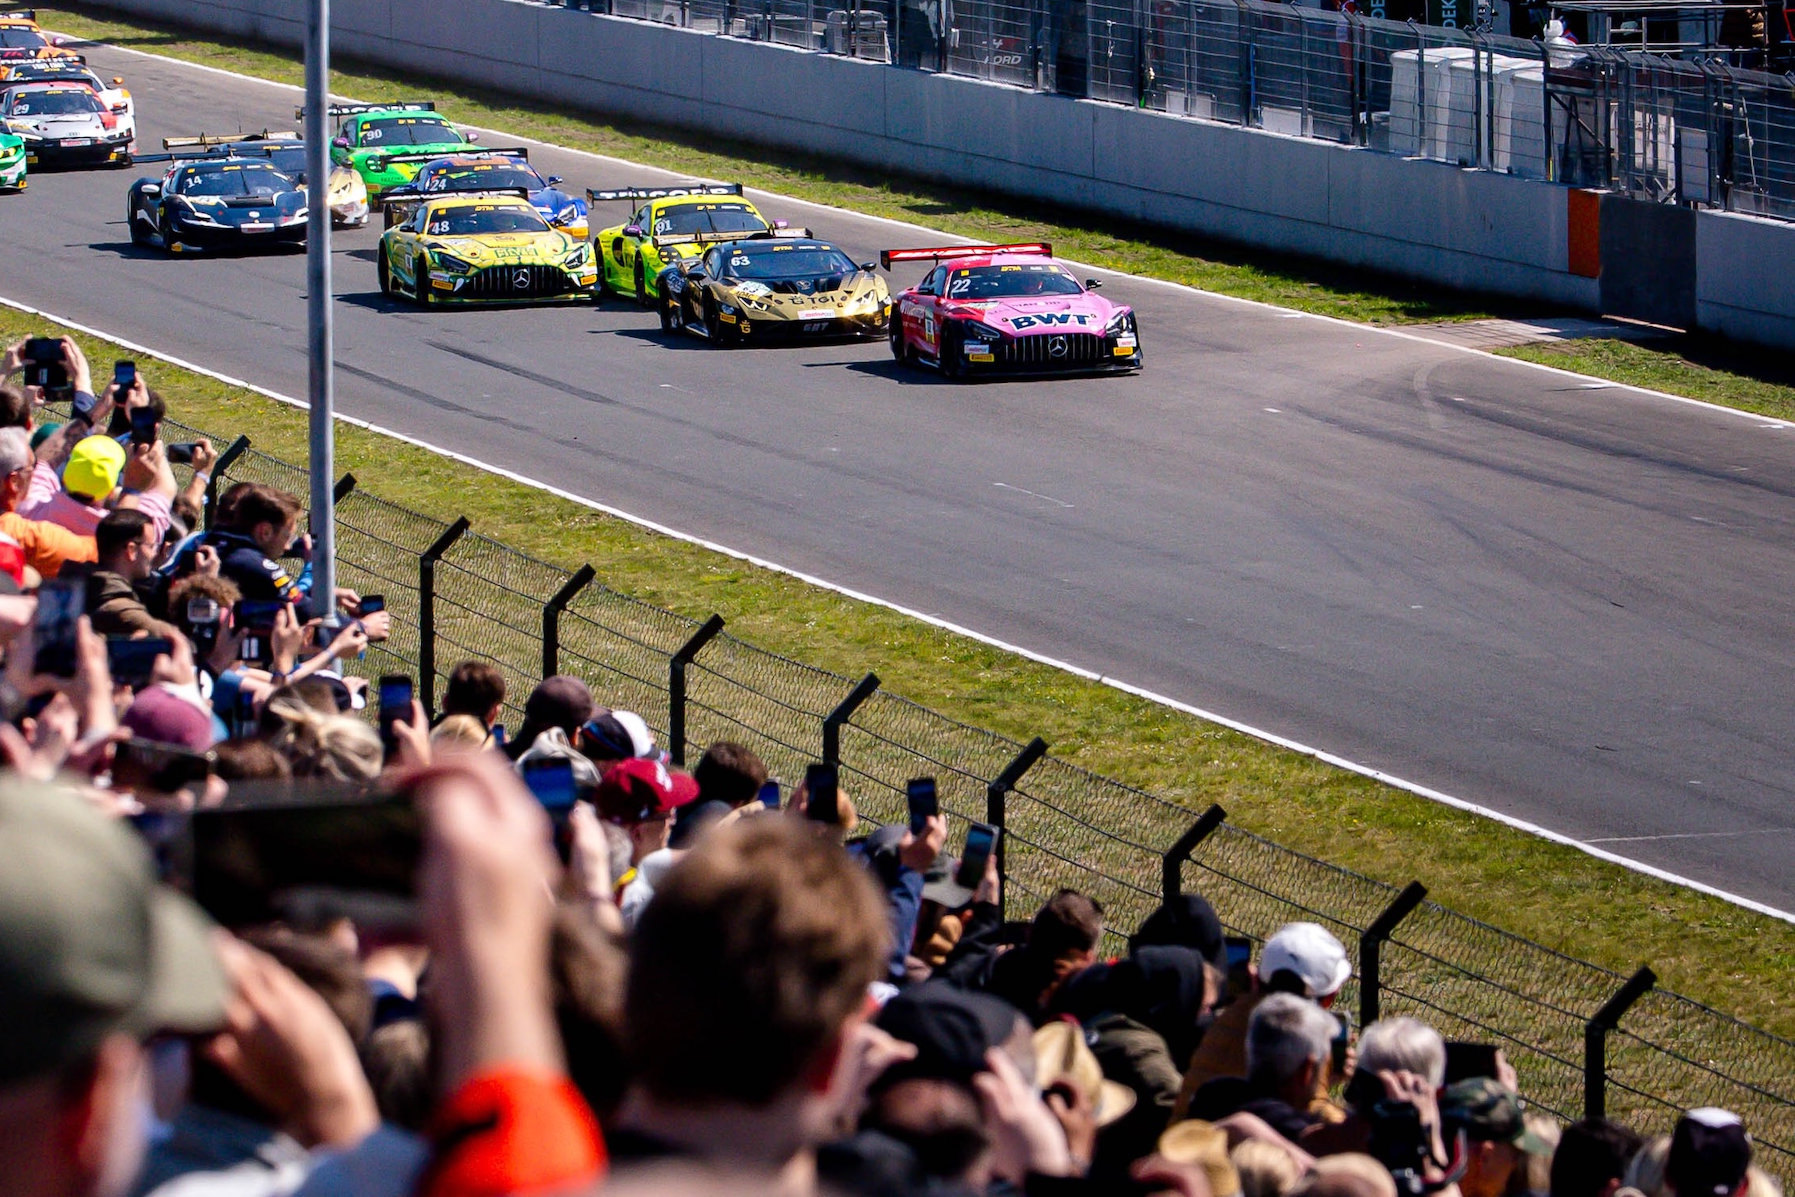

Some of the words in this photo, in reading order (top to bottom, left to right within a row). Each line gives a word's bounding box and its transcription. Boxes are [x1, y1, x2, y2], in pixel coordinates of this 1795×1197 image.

[367, 128, 383, 141] 90
[185, 175, 203, 188] 14
[431, 179, 447, 192] 24
[432, 221, 450, 234] 48
[657, 220, 673, 233] 91
[730, 256, 751, 267] 63
[952, 279, 971, 294] 22
[1010, 313, 1090, 331] BWT
